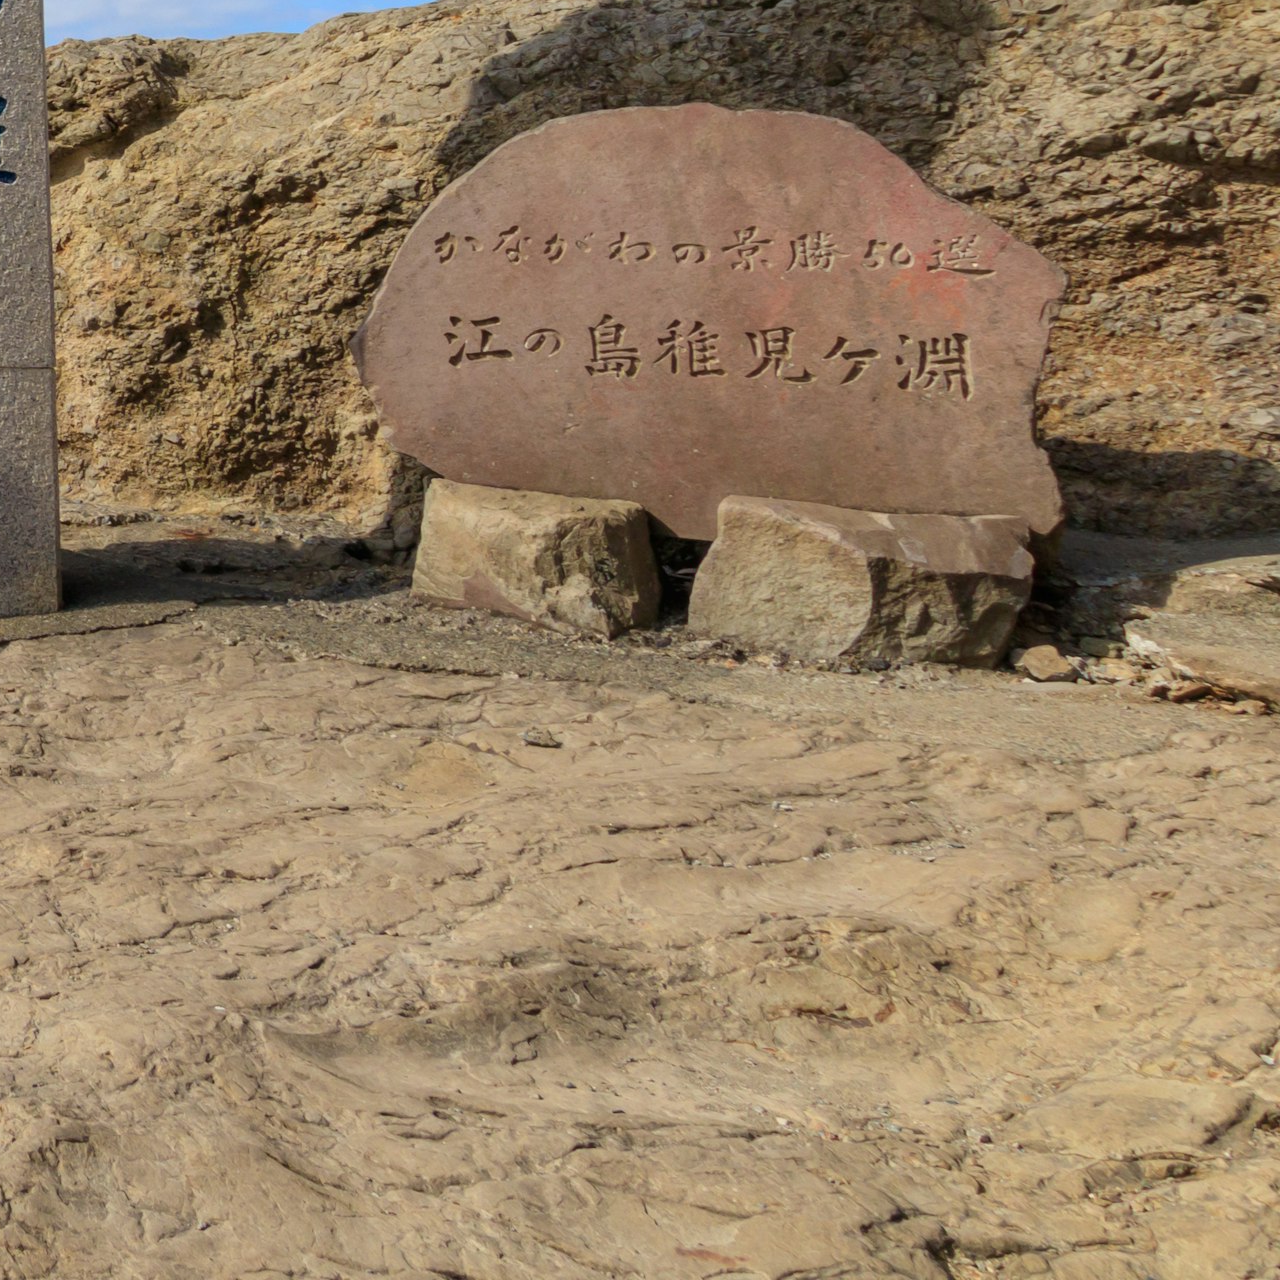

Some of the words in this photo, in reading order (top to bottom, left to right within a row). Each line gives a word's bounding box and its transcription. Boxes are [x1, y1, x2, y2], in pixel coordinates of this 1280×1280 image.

[435, 225, 997, 275] かながわの景勝50選
